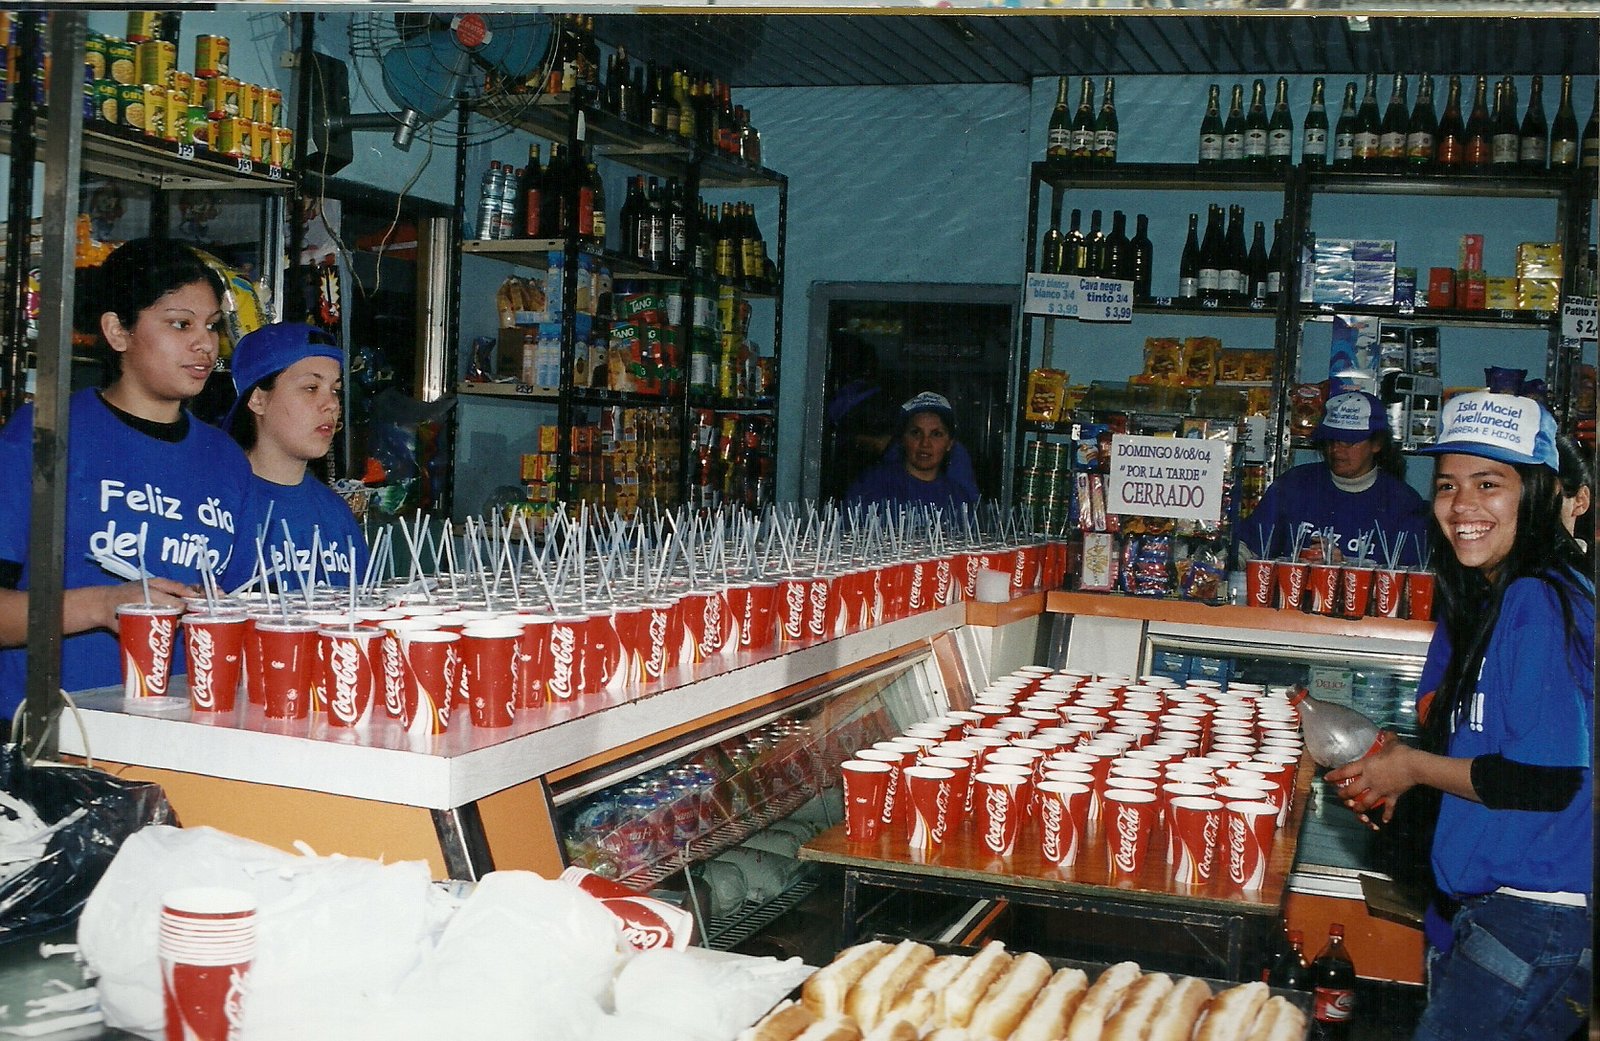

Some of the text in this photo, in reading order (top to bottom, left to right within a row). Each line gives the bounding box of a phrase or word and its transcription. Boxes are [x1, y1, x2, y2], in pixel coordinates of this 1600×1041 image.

[1080, 278, 1122, 294] Cava negra
[629, 297, 652, 313] TANG
[1086, 292, 1128, 303] tinto 3/4
[1057, 303, 1078, 316] 3,99
[1105, 306, 1131, 319] $ 3,99
[1565, 306, 1589, 317] Patito
[611, 327, 635, 339] TANG
[1586, 320, 1598, 336] 2,
[1456, 400, 1523, 419] Isla Maciel
[1453, 411, 1519, 432] Avellaneda
[1482, 427, 1488, 436] E
[1491, 428, 1521, 444] HIJOS
[1118, 444, 1211, 464] DOMINGO 8/08/04
[1149, 466, 1163, 479] LA
[101, 479, 183, 521] Feliz
[1121, 481, 1205, 508] CERRADO
[90, 520, 149, 557] del
[273, 540, 311, 572] eliz
[145, 614, 172, 695] Coca-Cola
[547, 622, 576, 698] Coca-Cola
[190, 624, 216, 708] Coca-Cola
[332, 636, 360, 722] Coca-Cola
[984, 783, 1008, 853] Coca-Cola
[1042, 791, 1063, 862] Coca-Cola
[1115, 802, 1140, 874] Coca-Cola
